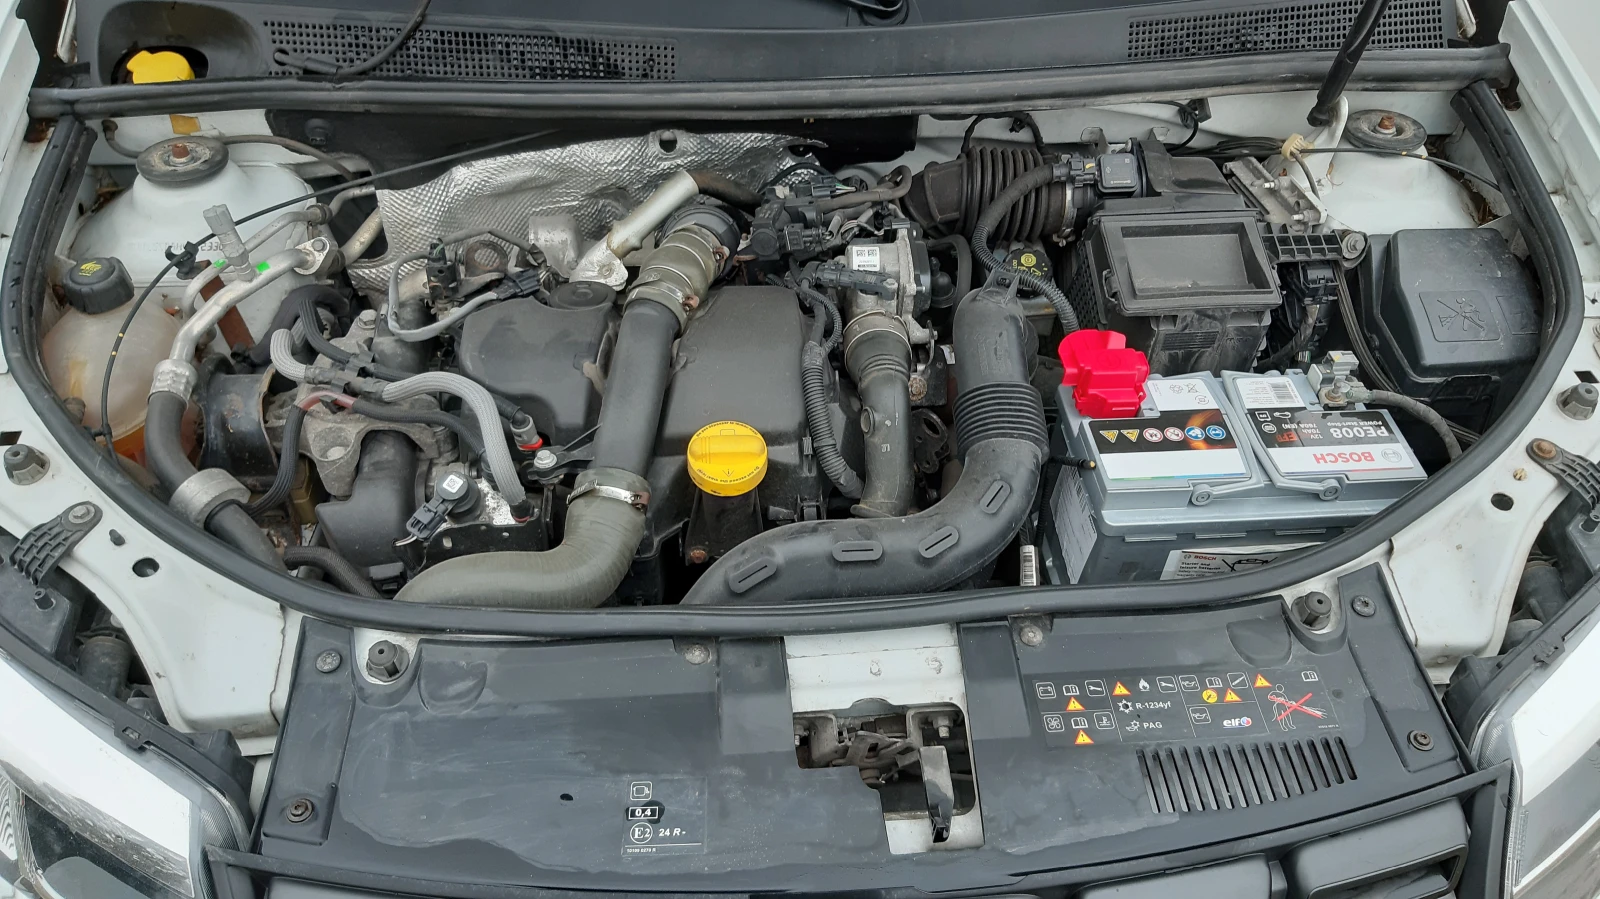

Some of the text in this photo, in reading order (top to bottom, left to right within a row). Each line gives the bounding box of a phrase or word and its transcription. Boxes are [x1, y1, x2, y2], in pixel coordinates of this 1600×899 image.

[1330, 426, 1389, 438] PE008
[1313, 451, 1375, 464] BOSCH
[1135, 701, 1171, 710] R-1234yf
[1143, 721, 1162, 729] PAG
[1223, 718, 1241, 727] elf
[635, 808, 651, 818] 0,4
[634, 827, 651, 839] E2
[659, 828, 670, 836] 24
